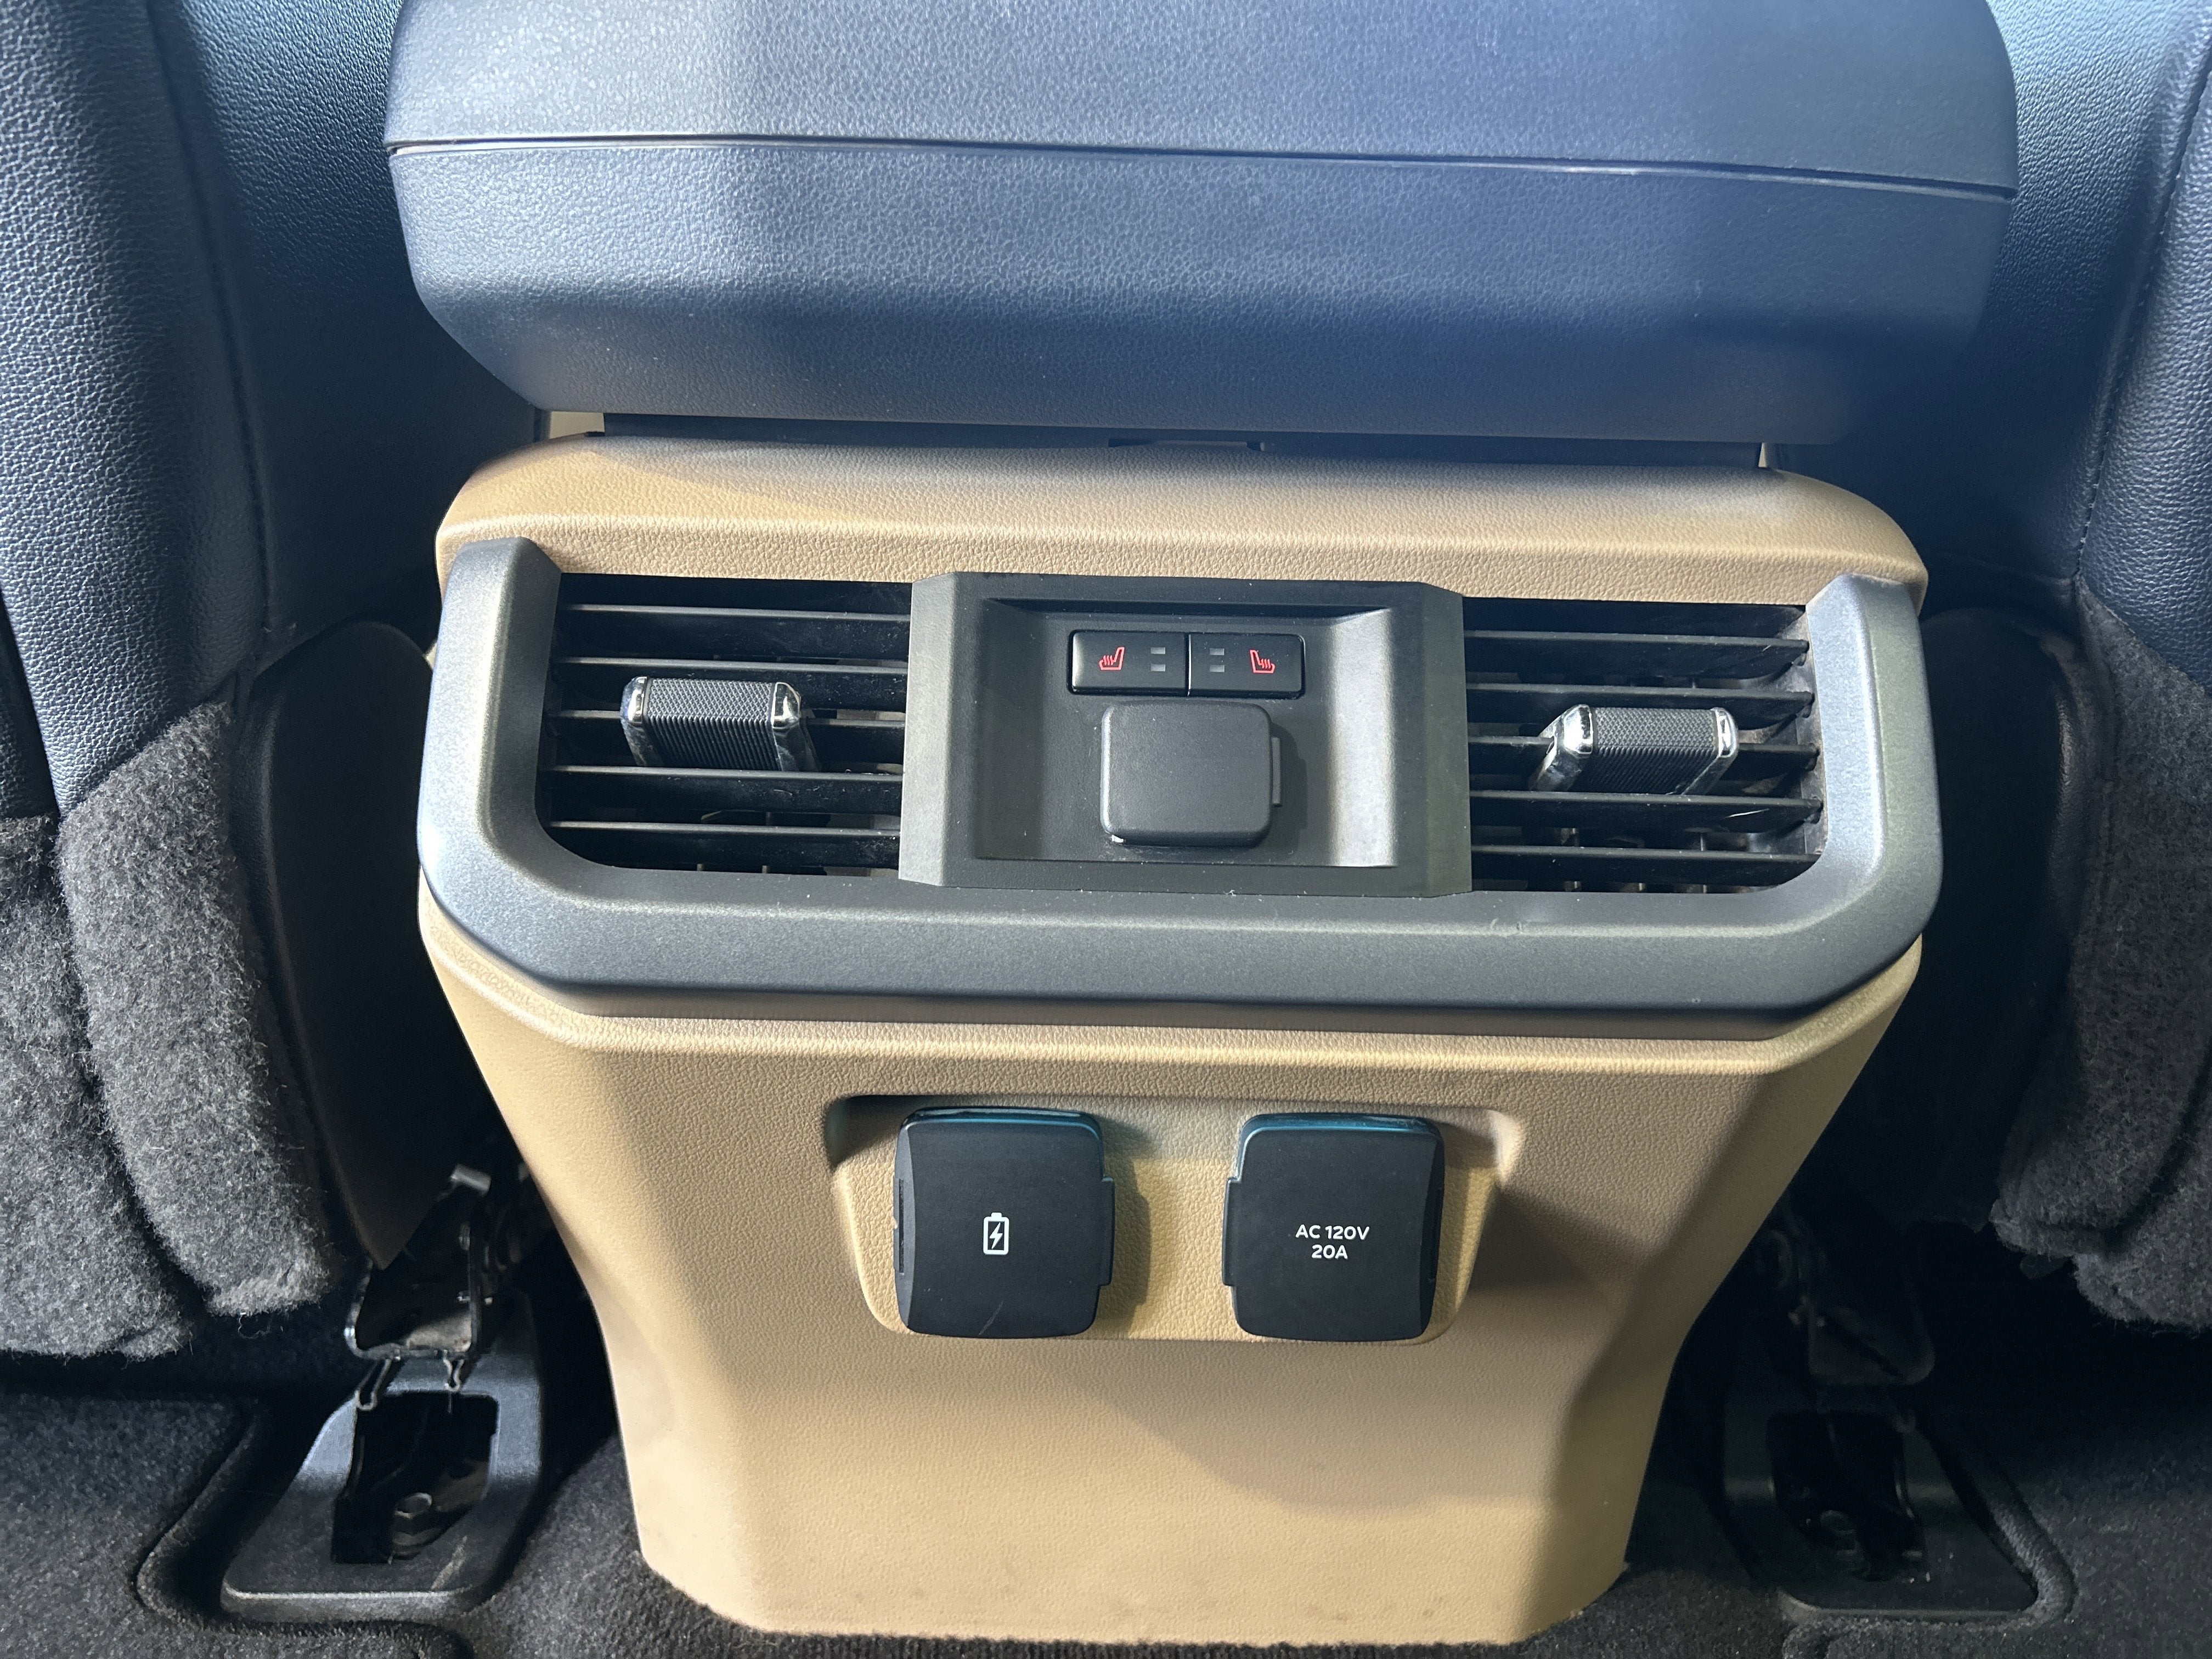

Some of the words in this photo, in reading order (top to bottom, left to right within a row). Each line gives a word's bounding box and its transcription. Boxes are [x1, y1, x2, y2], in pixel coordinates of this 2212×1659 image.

[1295, 1224, 1321, 1239] AC
[1325, 1225, 1370, 1240] 120V
[1311, 1244, 1348, 1260] 20A
